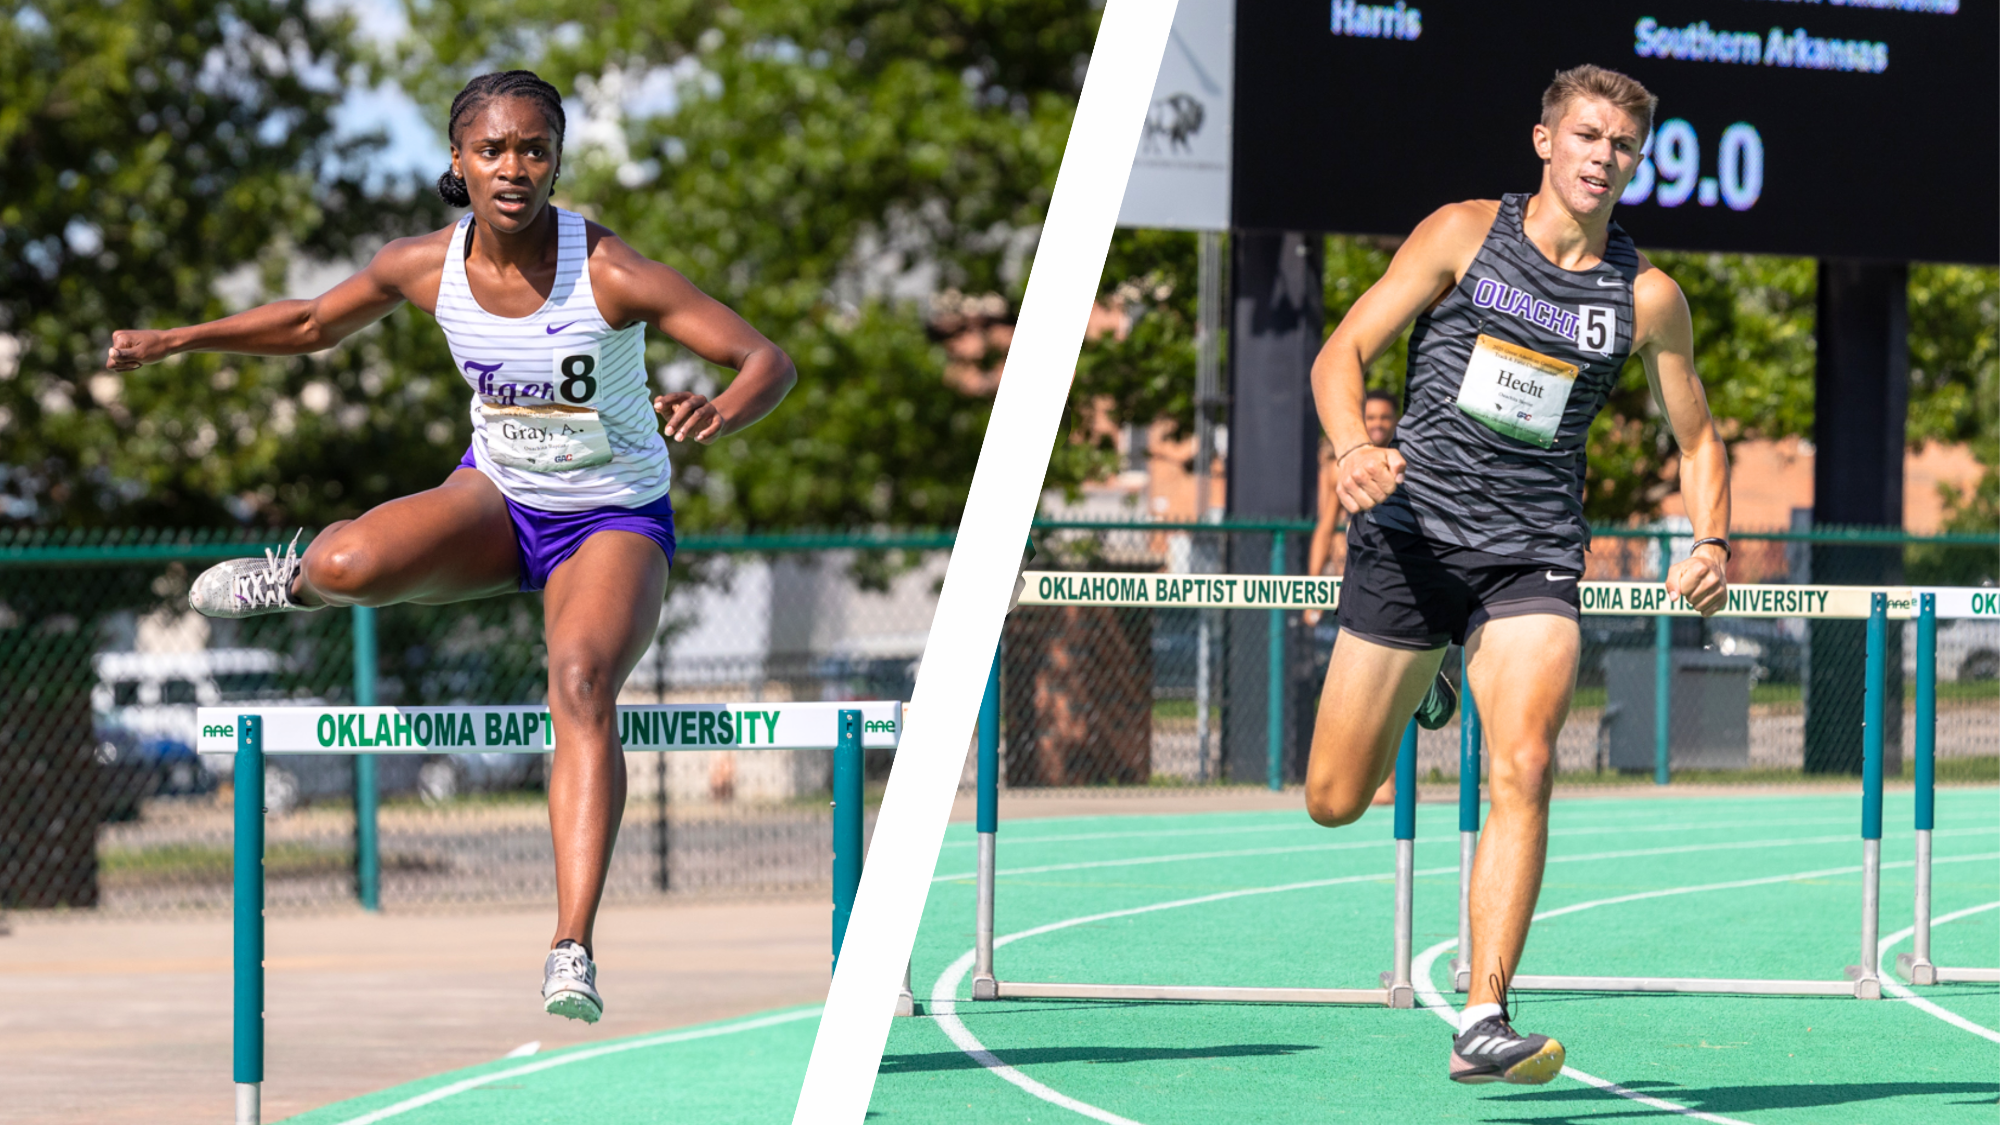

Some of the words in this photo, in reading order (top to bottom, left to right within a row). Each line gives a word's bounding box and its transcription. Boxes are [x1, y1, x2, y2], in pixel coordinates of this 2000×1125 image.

[1330, 0, 1422, 41] Harris
[1635, 16, 1761, 65] Southern
[1763, 26, 1889, 74] Arkansas
[1473, 277, 1581, 341] OUACHI
[1587, 309, 1607, 350] 5
[464, 361, 554, 405] Tiger
[560, 354, 597, 404] 8
[1495, 369, 1546, 399] Hecht
[502, 423, 554, 443] Gray,
[562, 423, 584, 436] A.
[1039, 576, 1149, 602] OKLAHOMA
[1156, 578, 1237, 603] BAPTIST
[1243, 579, 1343, 604] UNIVERSI
[1722, 589, 1829, 613] NIVERSITY
[317, 713, 476, 747] OKLAHOMA
[485, 712, 553, 746] BAPT
